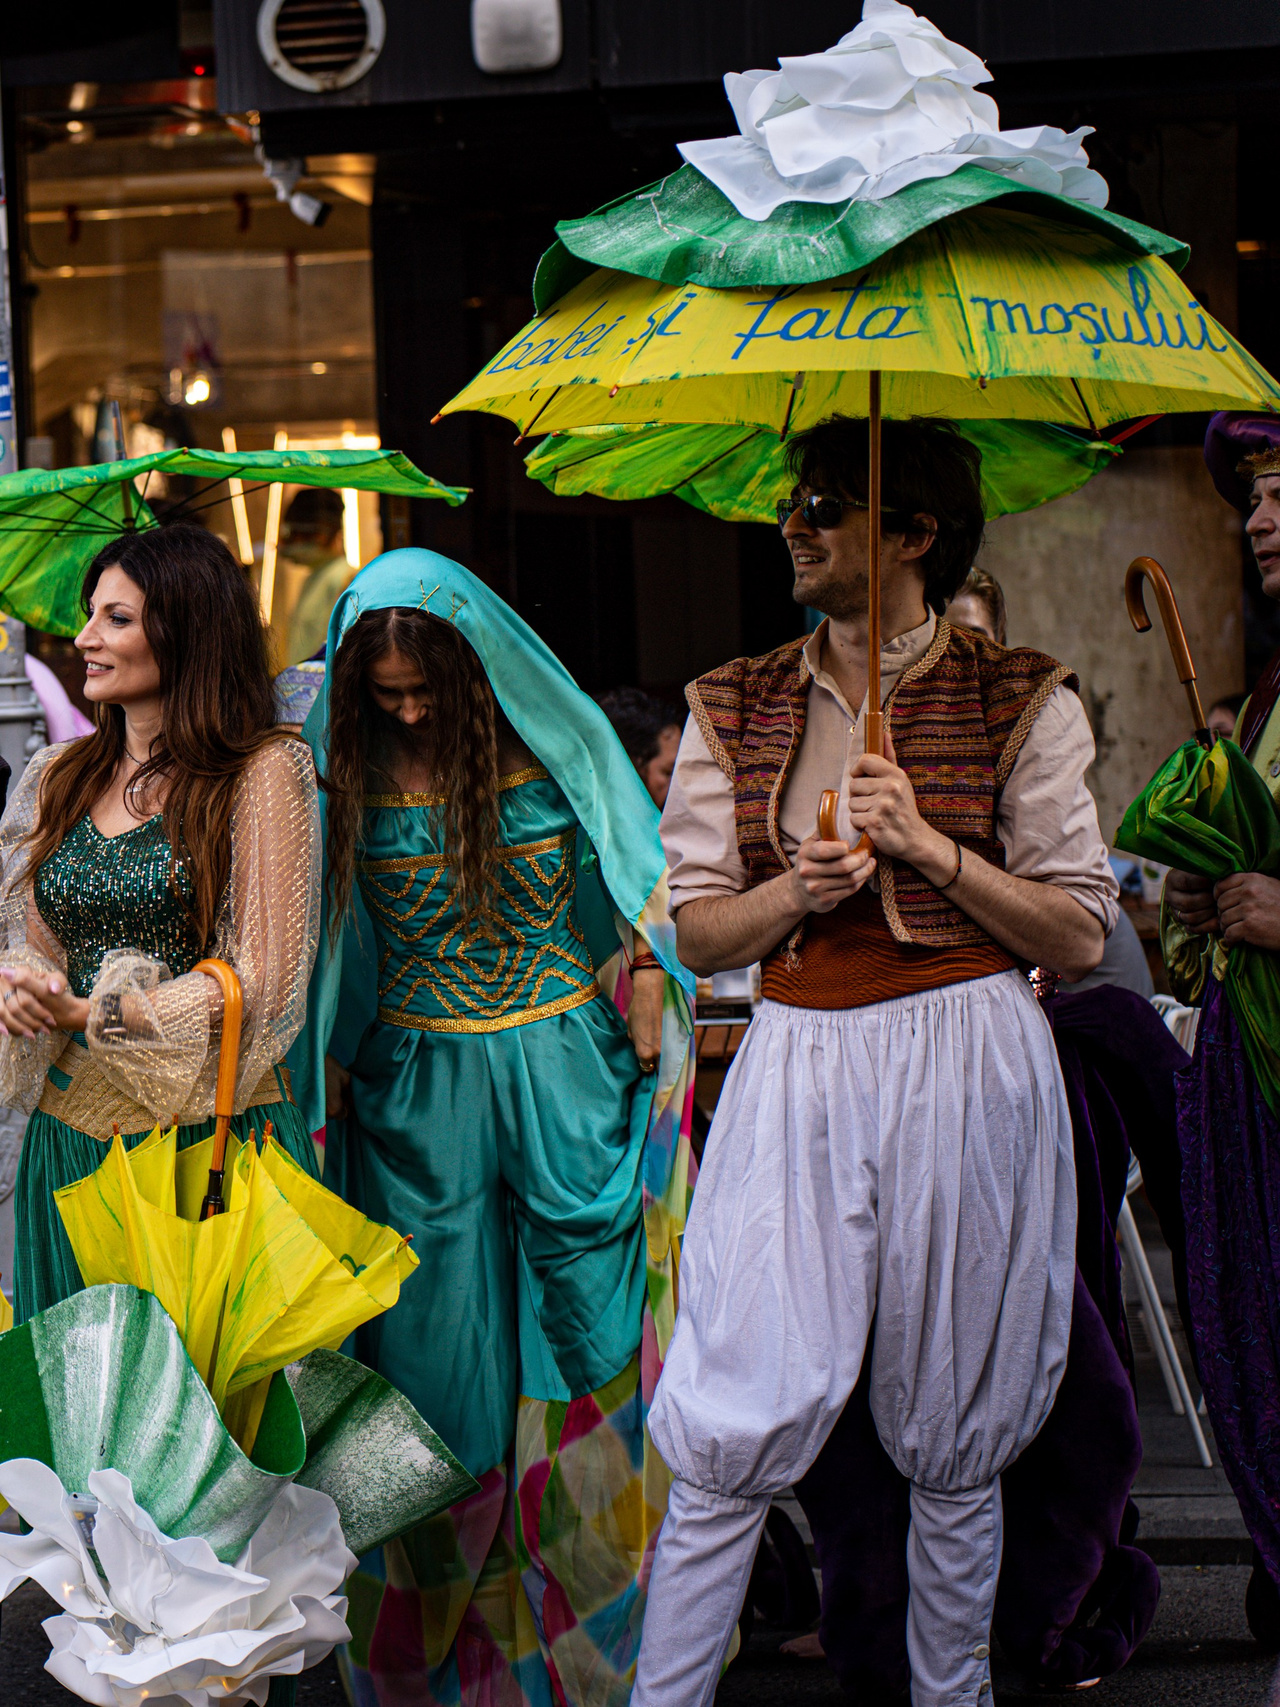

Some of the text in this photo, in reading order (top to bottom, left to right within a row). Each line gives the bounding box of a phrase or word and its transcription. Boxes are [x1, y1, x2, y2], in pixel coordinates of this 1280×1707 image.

[486, 266, 1228, 376] babei și fata moșului
